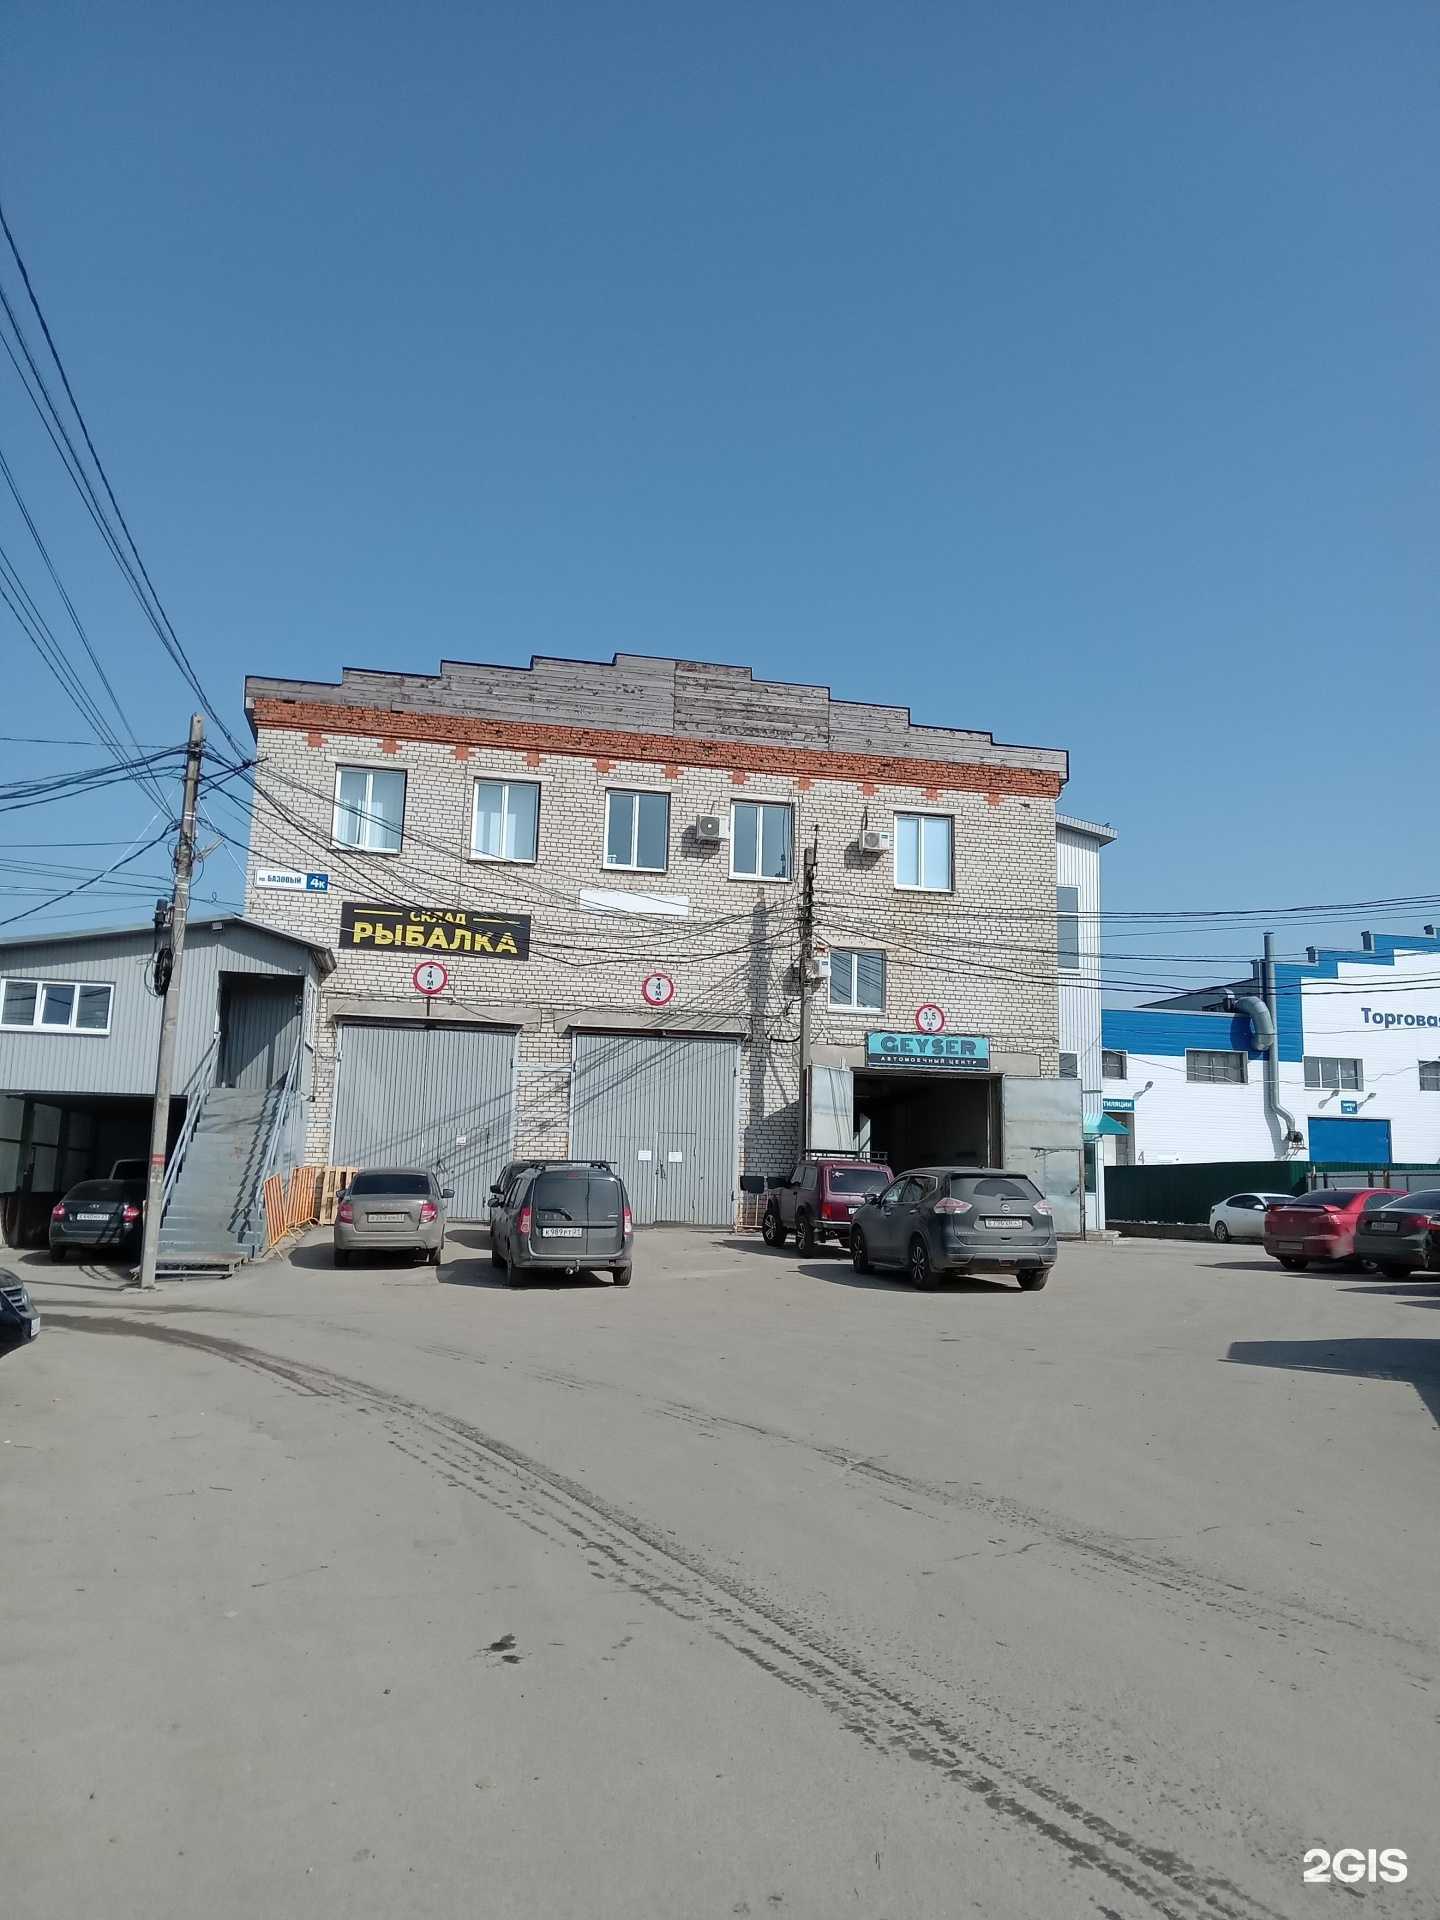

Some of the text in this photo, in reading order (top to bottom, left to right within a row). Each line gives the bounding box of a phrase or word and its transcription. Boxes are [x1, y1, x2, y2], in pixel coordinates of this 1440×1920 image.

[267, 874, 302, 884] БАЗОВЫЙ
[409, 911, 467, 926] СКЛАД
[352, 921, 519, 954] РЫБАЛКА
[1360, 1007, 1440, 1029] Торгова
[880, 1035, 977, 1056] GEYSER
[880, 1056, 945, 1064] АВТОМОЕЧНЫЙ
